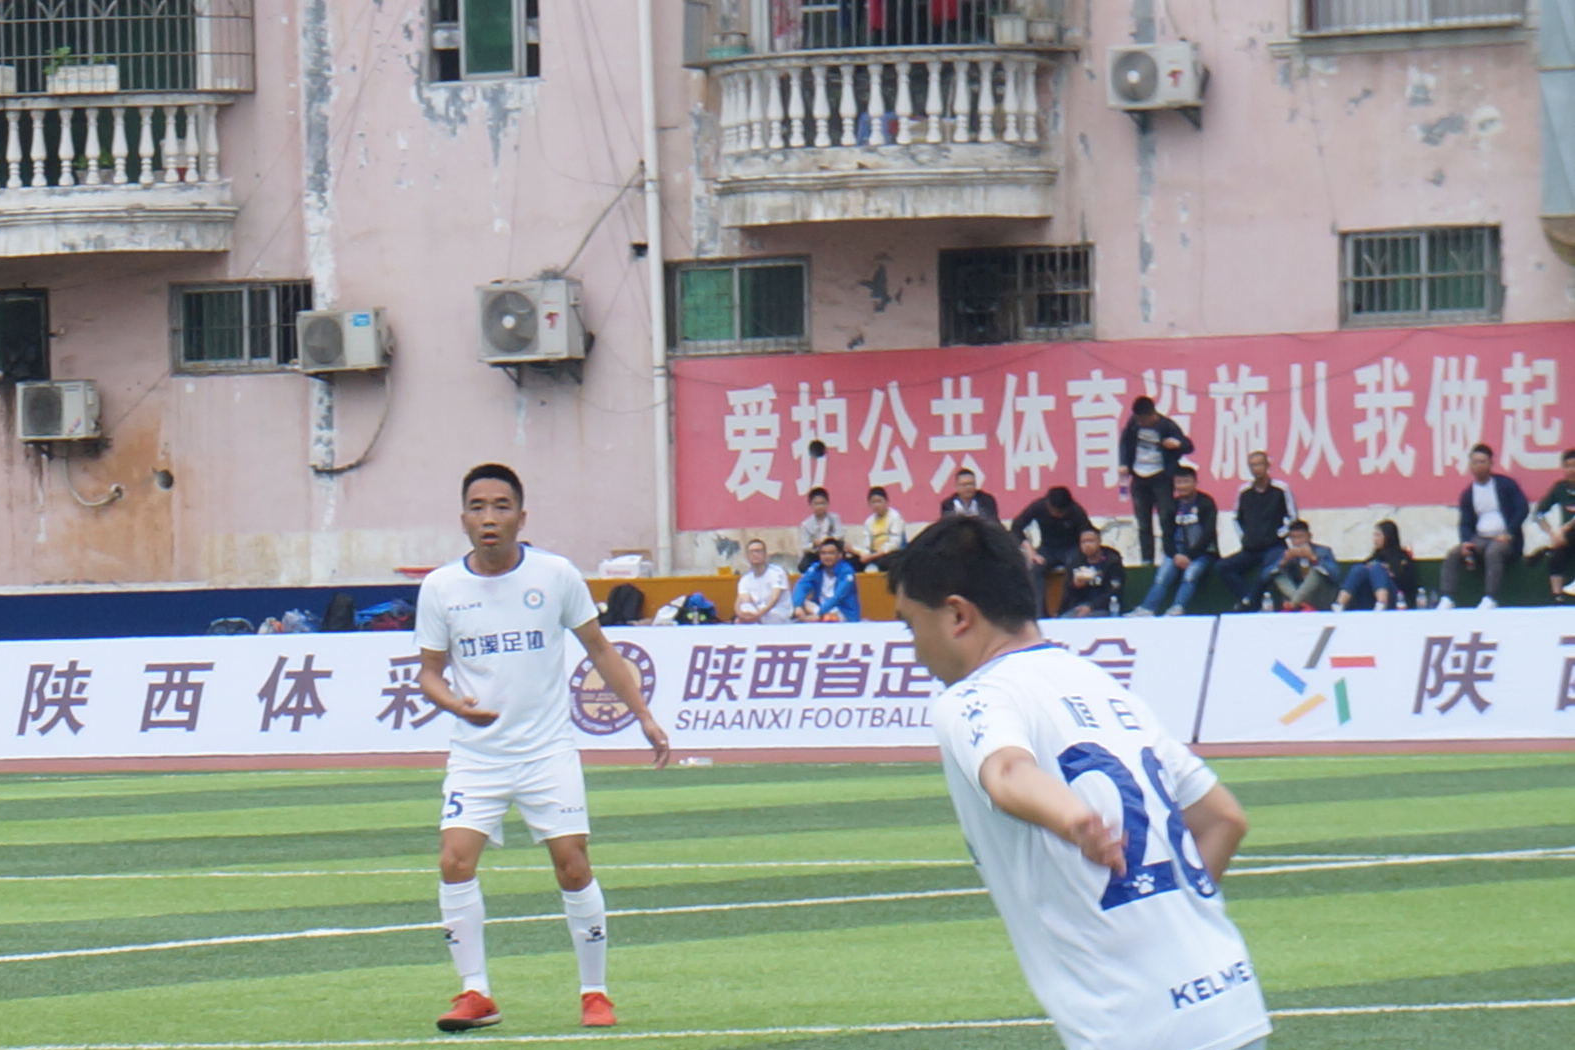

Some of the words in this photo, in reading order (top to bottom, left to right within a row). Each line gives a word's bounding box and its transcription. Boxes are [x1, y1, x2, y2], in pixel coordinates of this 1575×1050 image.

[724, 351, 1562, 500] 爱护公共体育设施从我做起
[674, 709, 792, 732] SHAANXI
[798, 705, 933, 730] FOOTBALL
[442, 791, 465, 818] 5
